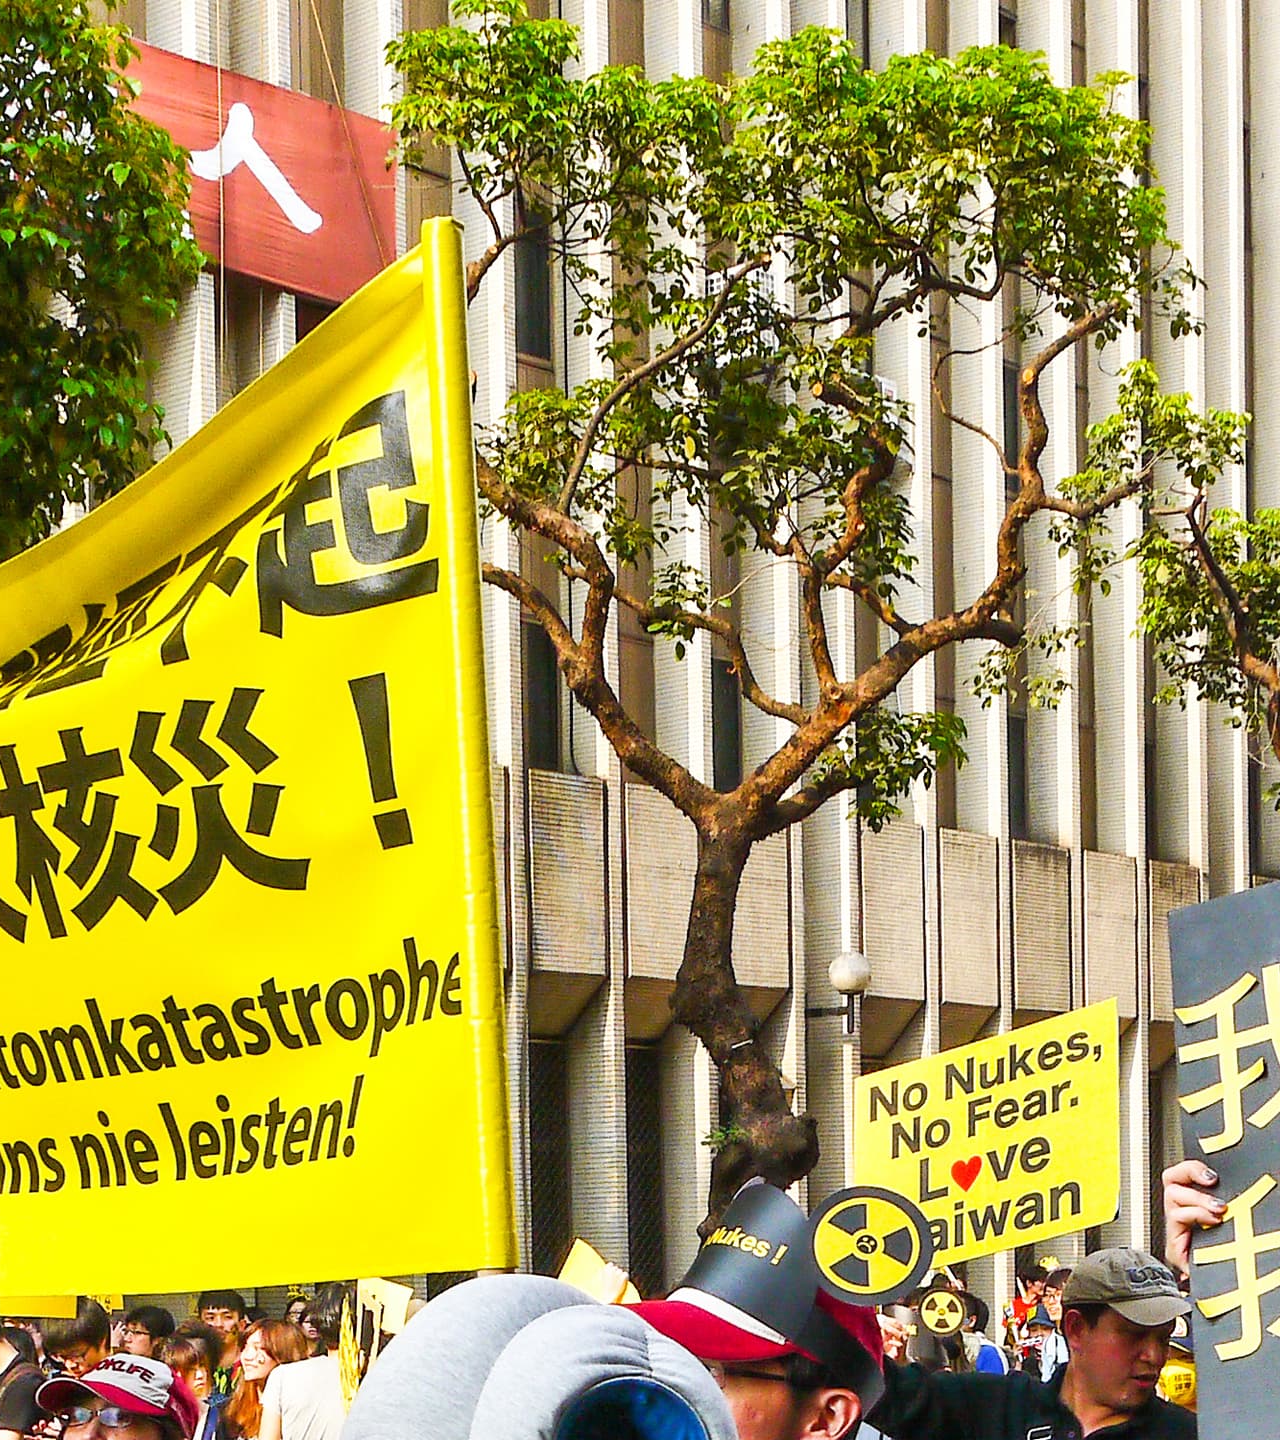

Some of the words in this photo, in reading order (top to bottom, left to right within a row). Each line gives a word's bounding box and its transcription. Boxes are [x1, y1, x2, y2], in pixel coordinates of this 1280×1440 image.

[869, 1080, 928, 1123] No
[945, 1031, 1102, 1101] Nukes,
[71, 1110, 158, 1190] nie
[158, 1074, 365, 1181] leisten!
[891, 1117, 951, 1159] No
[967, 1080, 1079, 1138] Fear.
[919, 1135, 1051, 1204] Lve
[929, 1180, 1082, 1252] aiwan
[93, 1358, 156, 1384] OKLIFE
